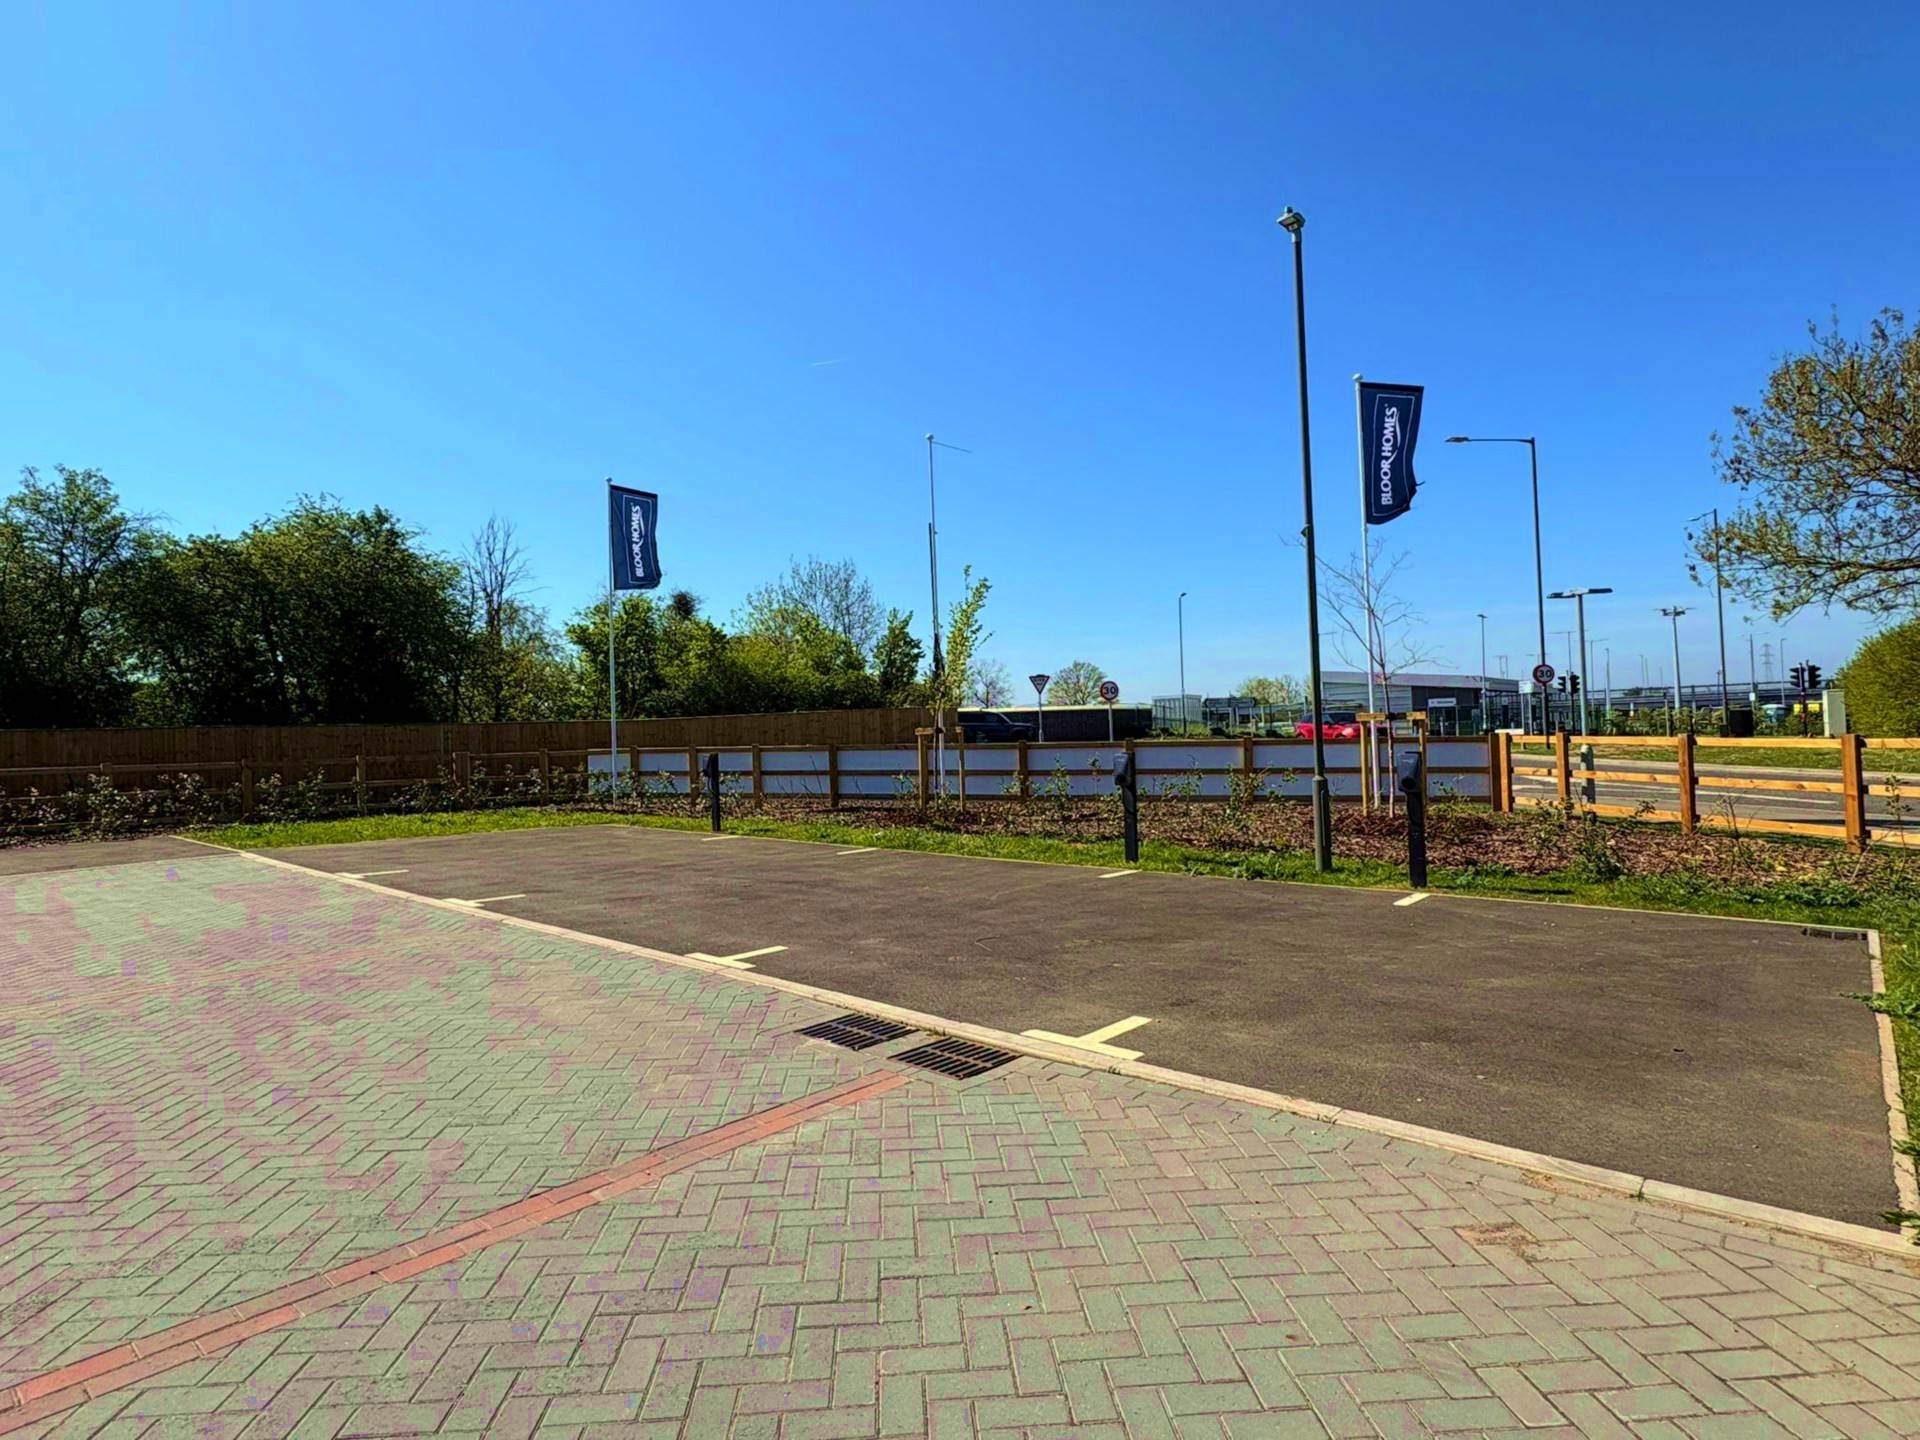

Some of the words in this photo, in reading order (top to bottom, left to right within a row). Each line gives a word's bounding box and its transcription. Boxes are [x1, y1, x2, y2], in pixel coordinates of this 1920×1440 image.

[1381, 406, 1397, 457] HOMES
[1380, 455, 1395, 504] BLOOR
[631, 505, 641, 542] HOMES
[632, 541, 644, 577] BLOOR
[1103, 686, 1116, 695] 30
[1539, 670, 1552, 679] 30
